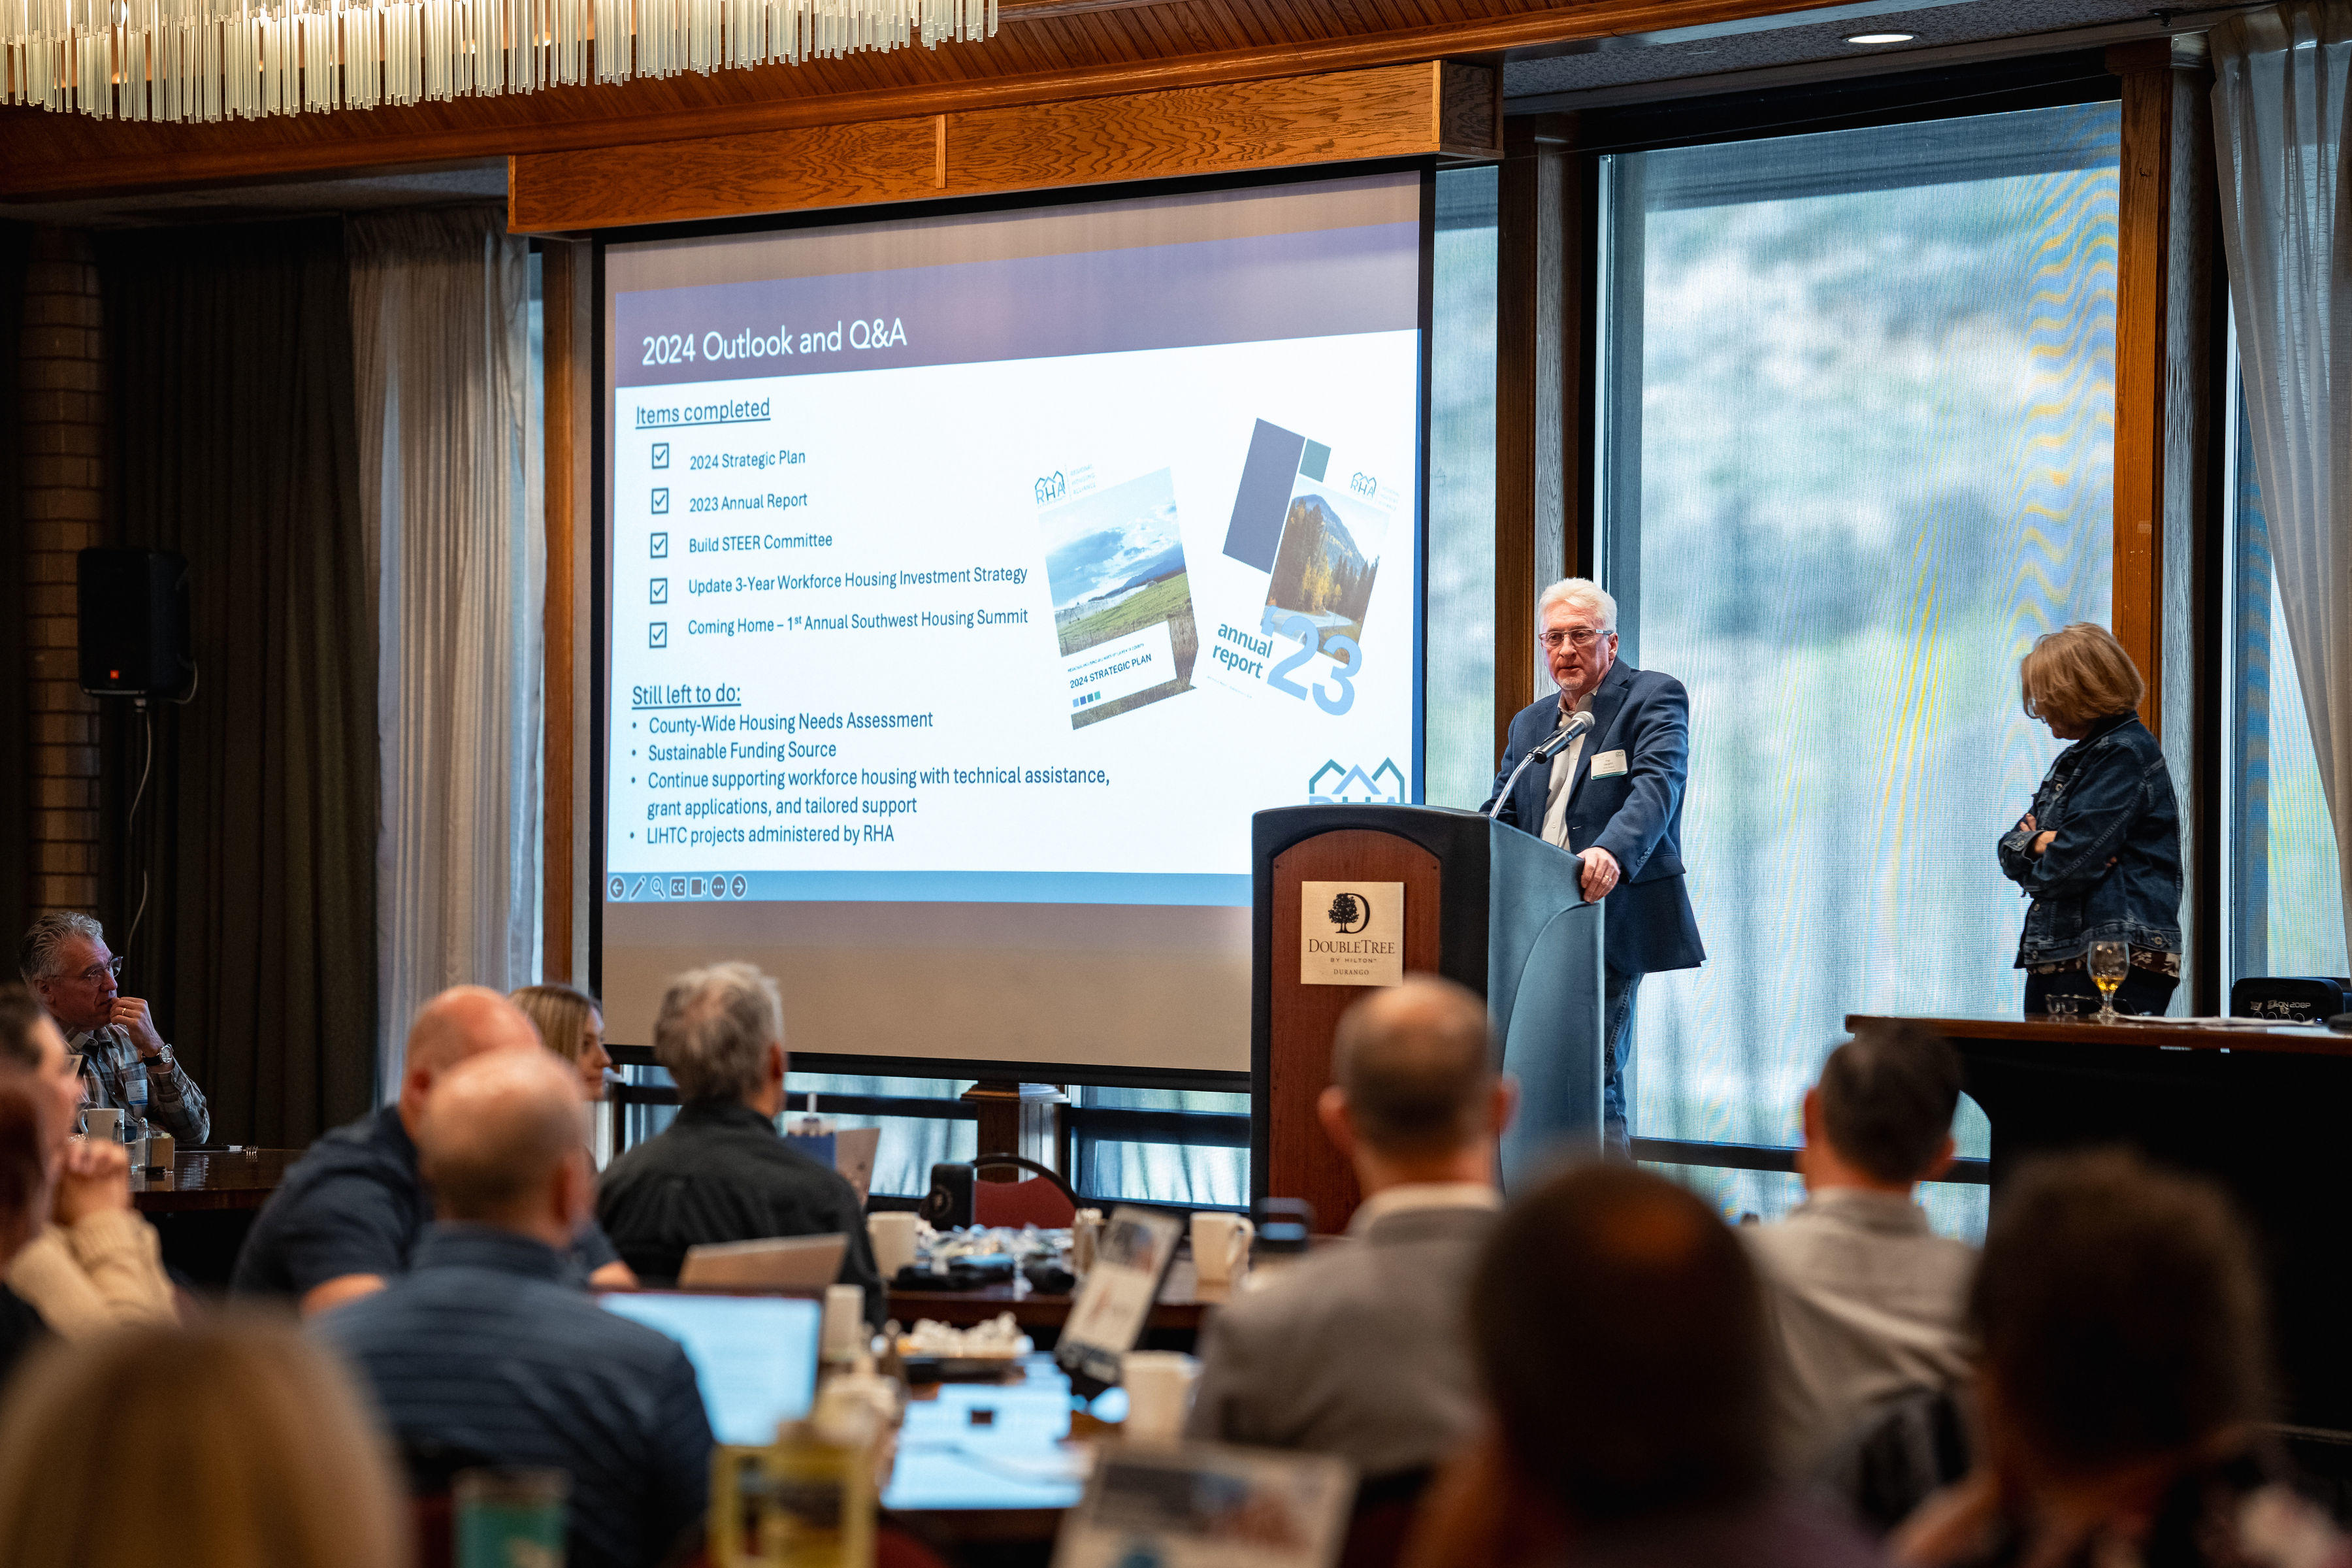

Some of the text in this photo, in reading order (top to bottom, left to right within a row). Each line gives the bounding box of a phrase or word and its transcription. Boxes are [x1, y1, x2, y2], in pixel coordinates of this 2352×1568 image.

[643, 318, 906, 365] 2024 Outlook and Q&A
[636, 397, 770, 425] Items completed
[690, 450, 805, 470] 2024 Strategic Plan
[1036, 482, 1066, 504] RHA
[1350, 479, 1374, 498] RHA
[690, 493, 808, 512] 2023 Annual Report
[689, 533, 832, 553] Build STEER Committee
[689, 567, 1027, 596] Update 3-Year Workforce Housing Investment Strategy
[689, 619, 734, 636] Coming
[738, 618, 774, 632] Home
[787, 615, 802, 630] 1st
[804, 614, 848, 630] Annual
[851, 613, 918, 629] Southwest
[922, 610, 974, 629] Housing
[977, 608, 1028, 625] Summit
[1218, 623, 1273, 659] annual
[1070, 676, 1088, 688] 2024
[1090, 661, 1130, 681] STRATEGIC
[1132, 653, 1152, 667] PLAN
[1213, 644, 1263, 679] report
[632, 683, 741, 706] Still left to do:
[649, 712, 933, 736] County-Wide Housing Needs Assessment
[649, 741, 836, 762] Sustainable Funding Source
[648, 766, 1109, 791] Continue supporting workforce housing with technical assistance,
[647, 796, 917, 821] grant applications, and tailored support
[647, 825, 894, 847] LIHTC projects administered by RHA
